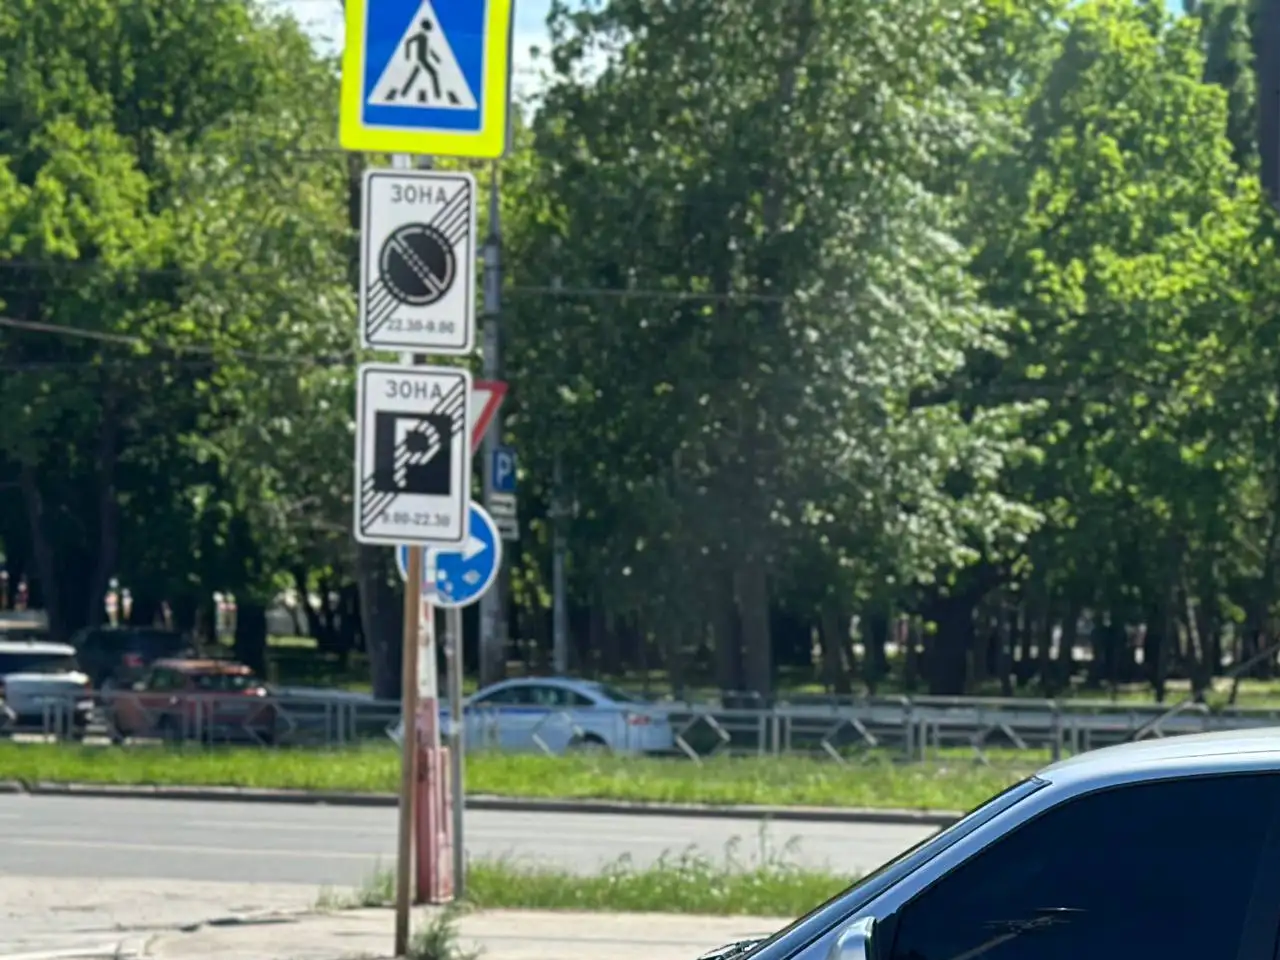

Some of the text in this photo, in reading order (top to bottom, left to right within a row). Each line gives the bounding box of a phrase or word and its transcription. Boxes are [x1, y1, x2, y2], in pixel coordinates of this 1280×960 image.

[390, 184, 447, 204] ЗОНА
[385, 379, 443, 399] ЗОНА
[394, 418, 441, 488] P
